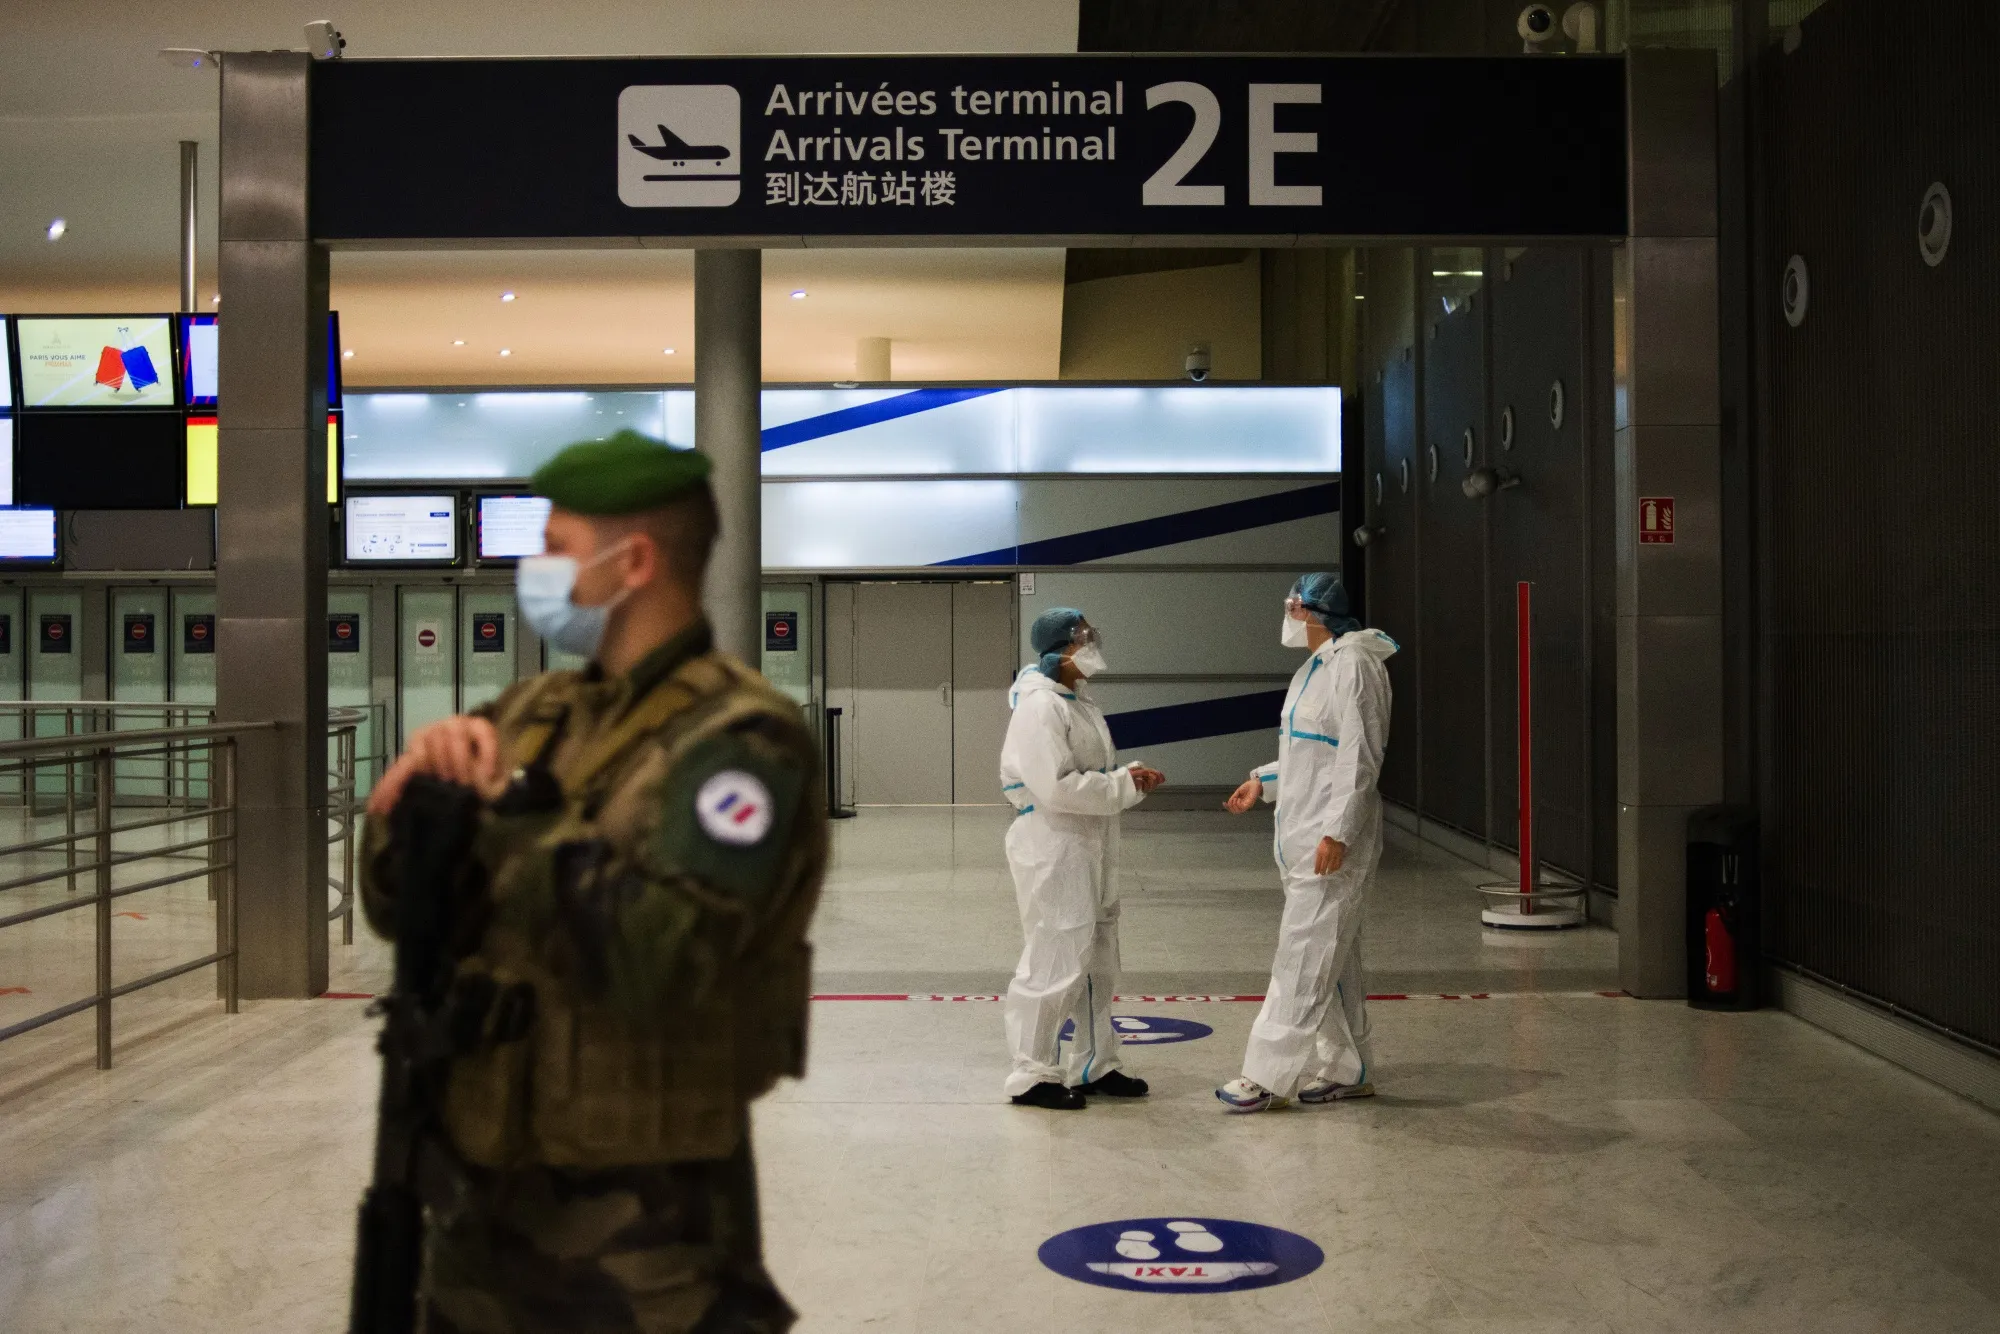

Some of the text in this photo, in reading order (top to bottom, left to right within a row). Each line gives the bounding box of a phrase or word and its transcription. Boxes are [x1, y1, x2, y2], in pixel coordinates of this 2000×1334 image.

[764, 80, 1124, 116] Arrivées terminal
[764, 126, 1116, 161] Arrivals Terminal
[1142, 80, 1324, 206] 2E
[764, 170, 957, 207] 到达航站楼
[1134, 1266, 1209, 1277] TAXI
